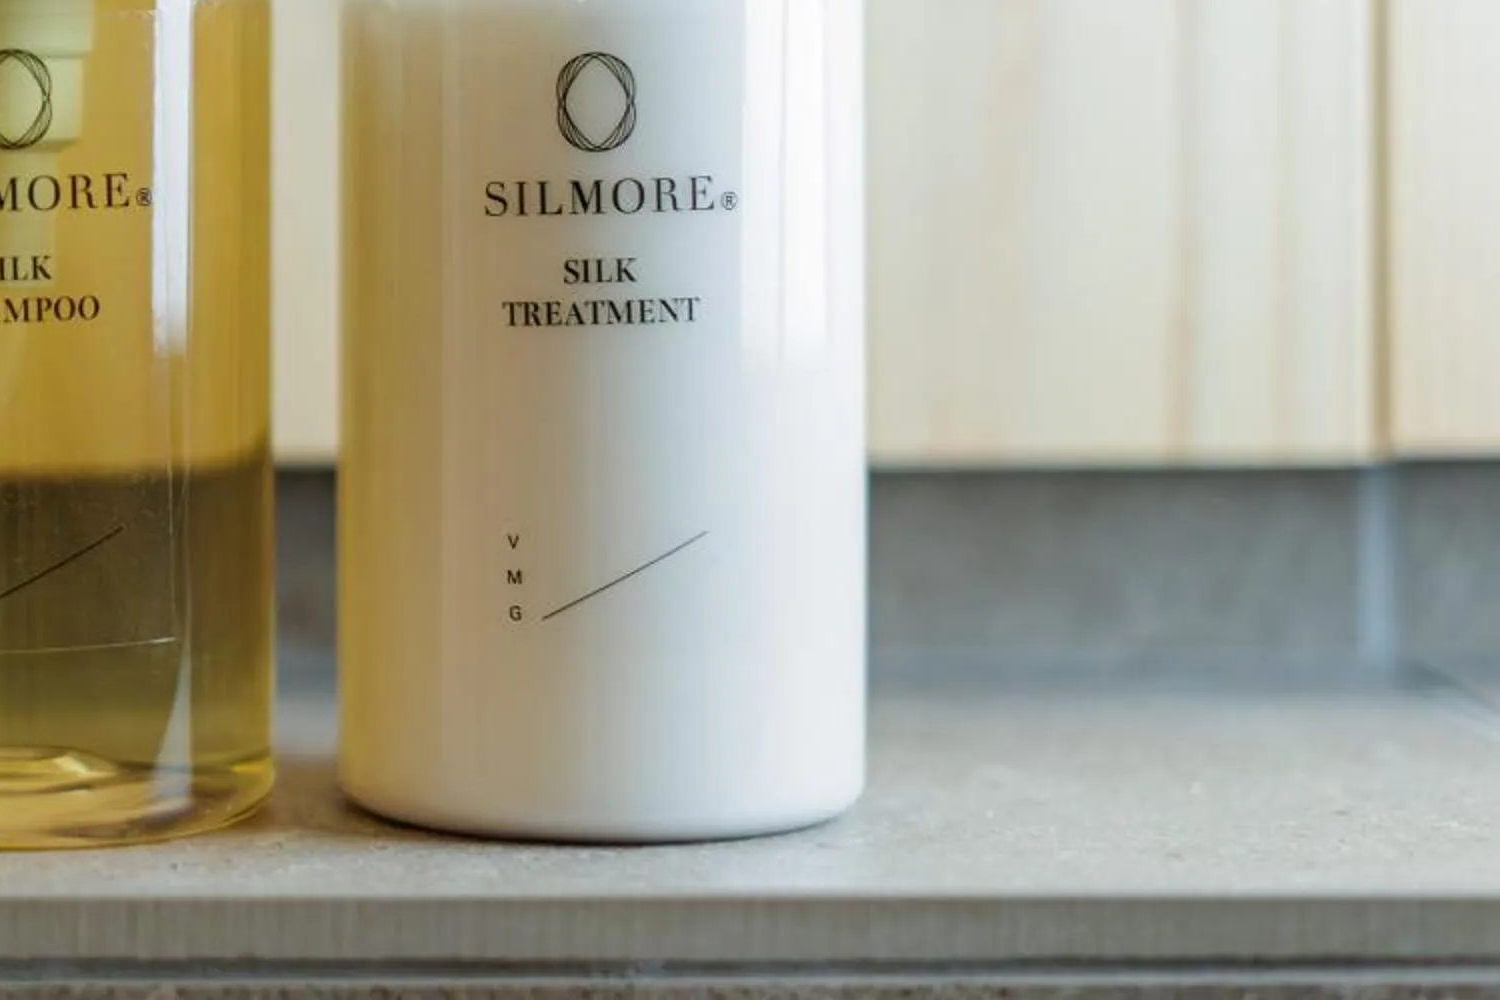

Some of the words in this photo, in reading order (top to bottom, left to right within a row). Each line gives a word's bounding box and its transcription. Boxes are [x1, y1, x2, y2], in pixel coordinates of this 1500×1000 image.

[562, 257, 638, 285] SILK
[501, 296, 701, 328] TREATMENT
[507, 534, 520, 550] V
[506, 570, 523, 585] M
[508, 605, 523, 622] G
